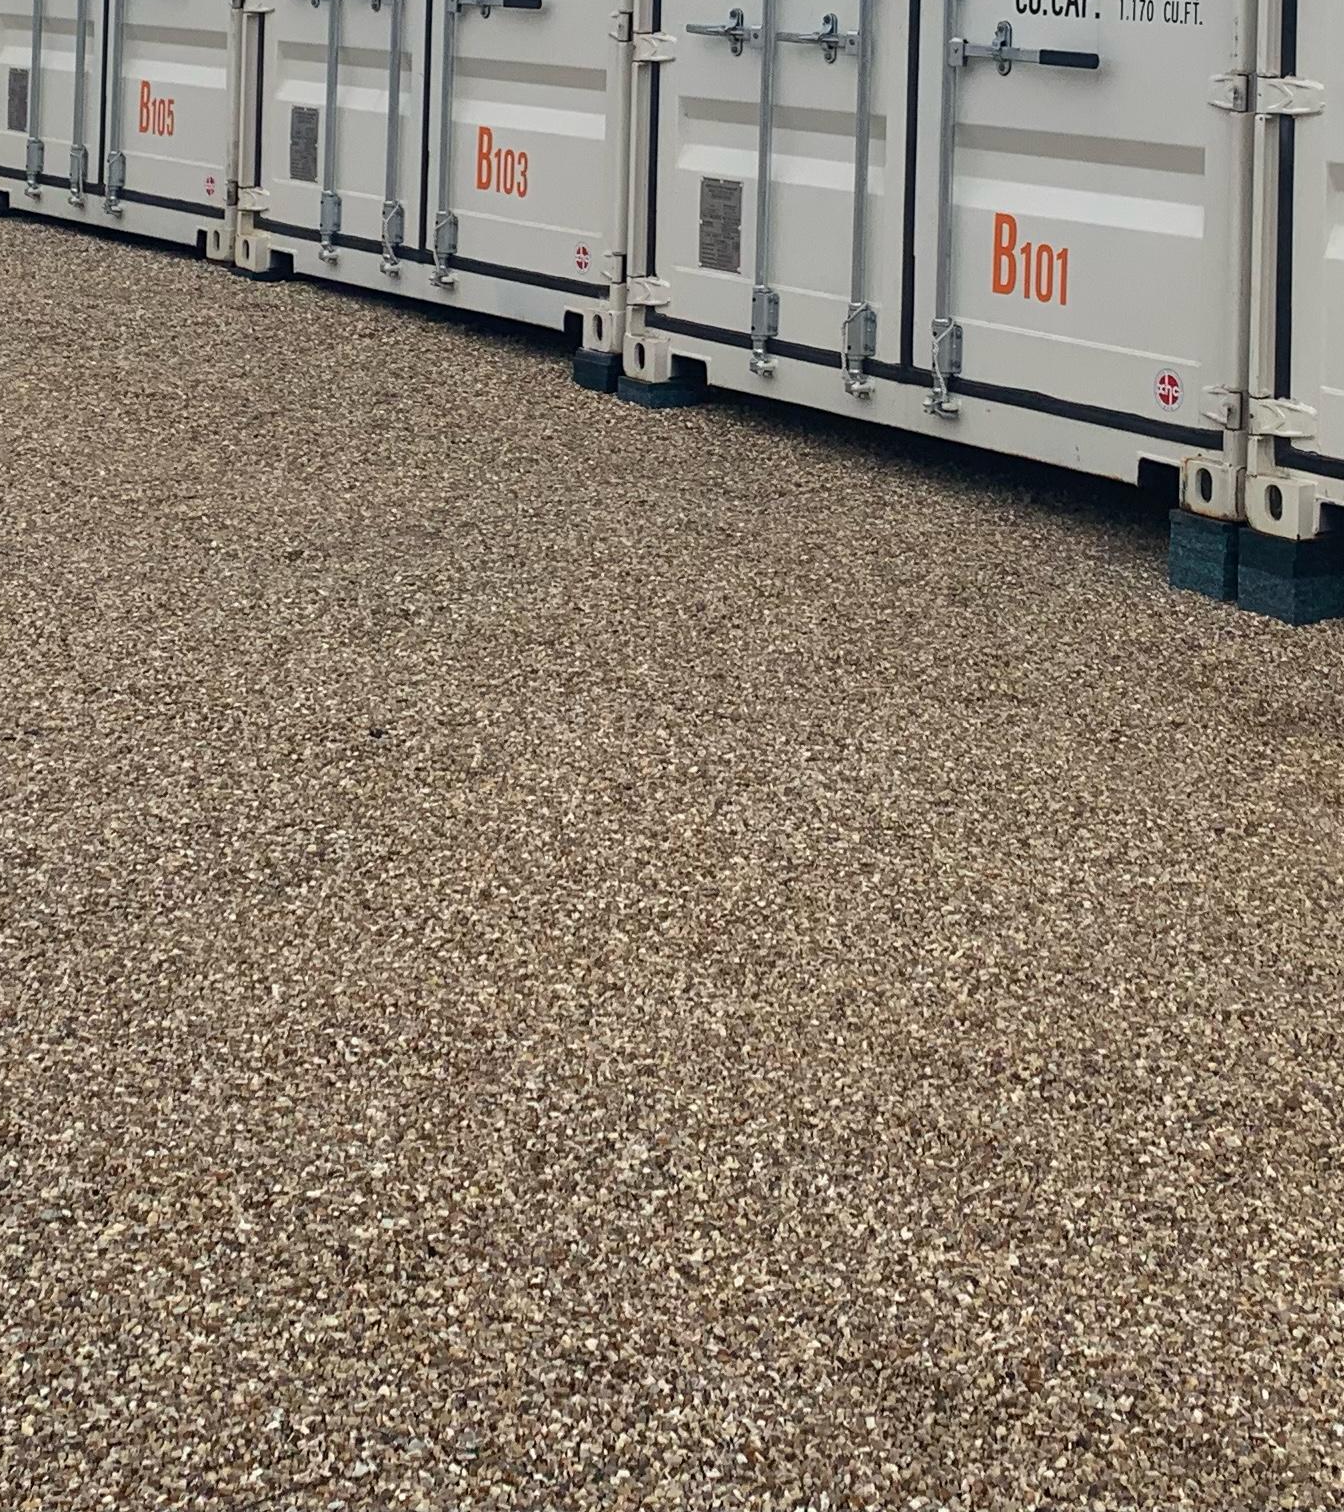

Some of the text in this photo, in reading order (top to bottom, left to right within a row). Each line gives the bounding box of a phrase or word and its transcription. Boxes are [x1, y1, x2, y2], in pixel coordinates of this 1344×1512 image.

[1163, 1, 1204, 26] CU.FT.
[139, 80, 174, 136] B105
[476, 126, 528, 198] B103
[992, 212, 1069, 306] B101
